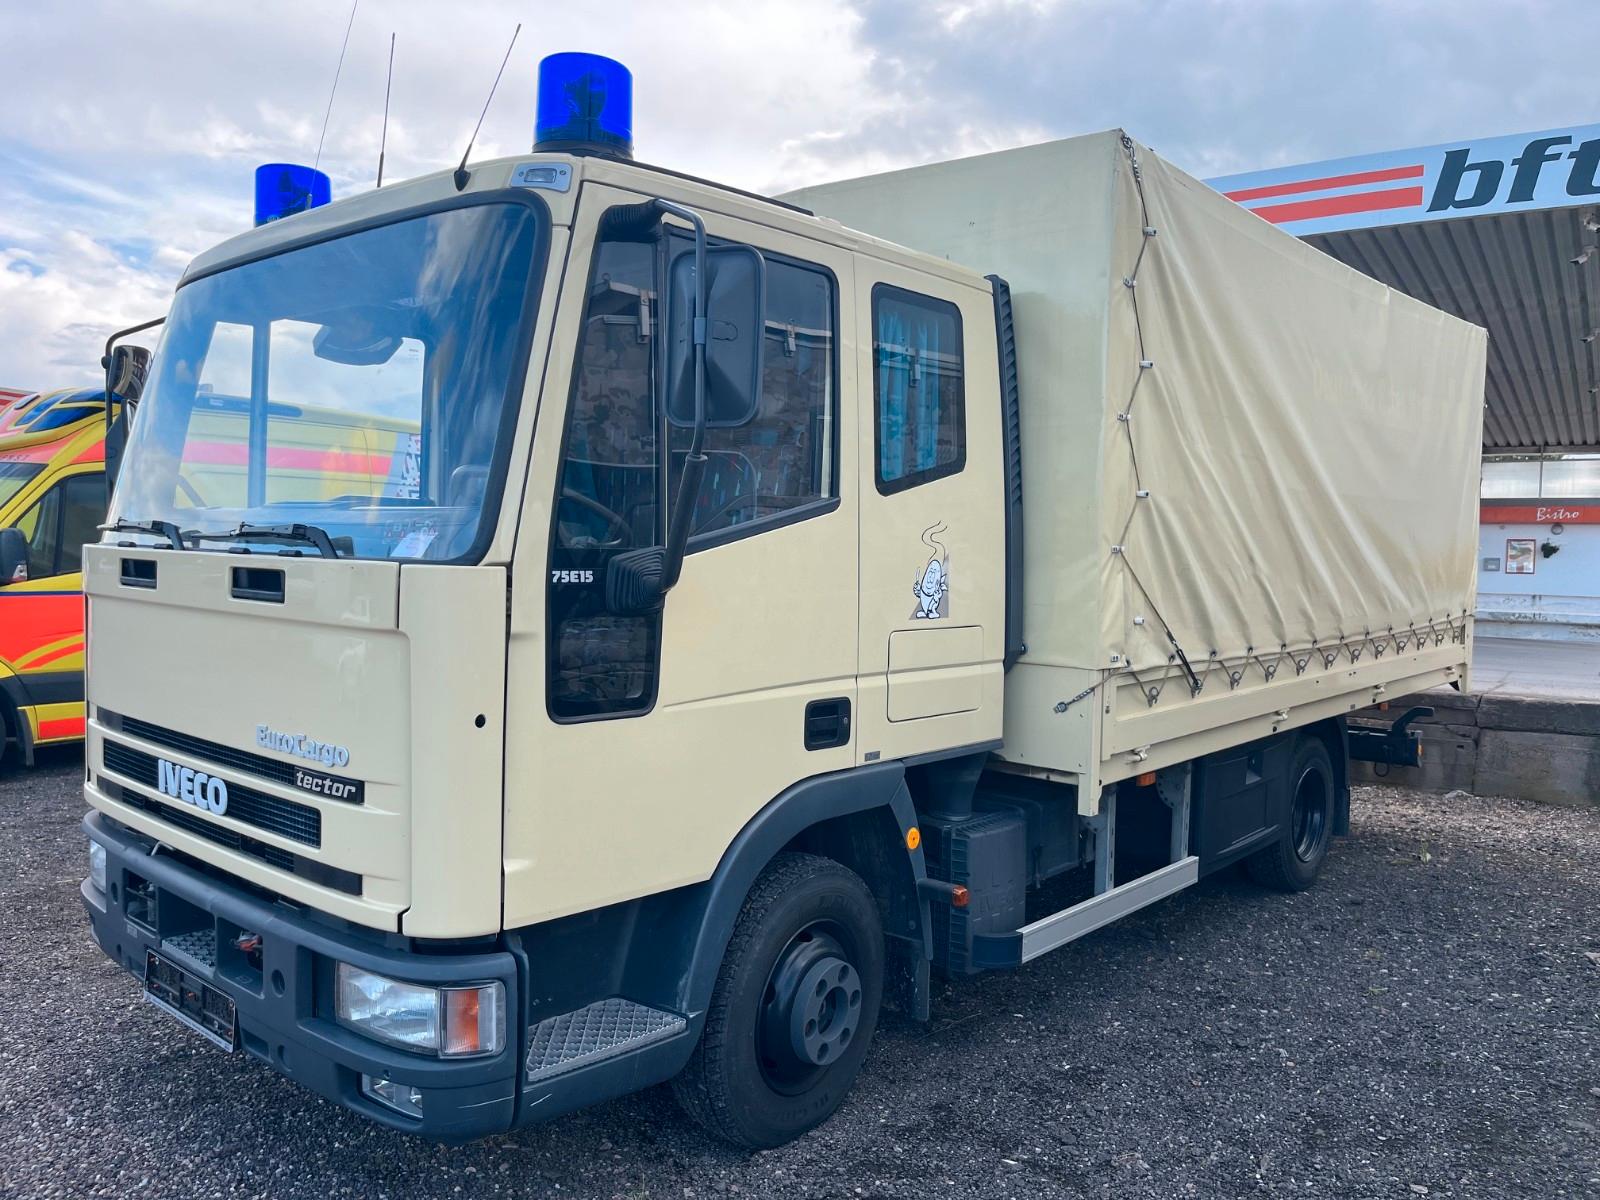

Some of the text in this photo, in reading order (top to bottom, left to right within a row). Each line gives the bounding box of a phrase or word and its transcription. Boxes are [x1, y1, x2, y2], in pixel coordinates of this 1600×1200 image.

[1426, 135, 1600, 212] bft
[1536, 507, 1580, 521] Bistro
[551, 570, 594, 583] 75E15
[256, 725, 349, 767] EuroCargo
[158, 759, 228, 816] IVECO
[296, 770, 356, 799] tector
